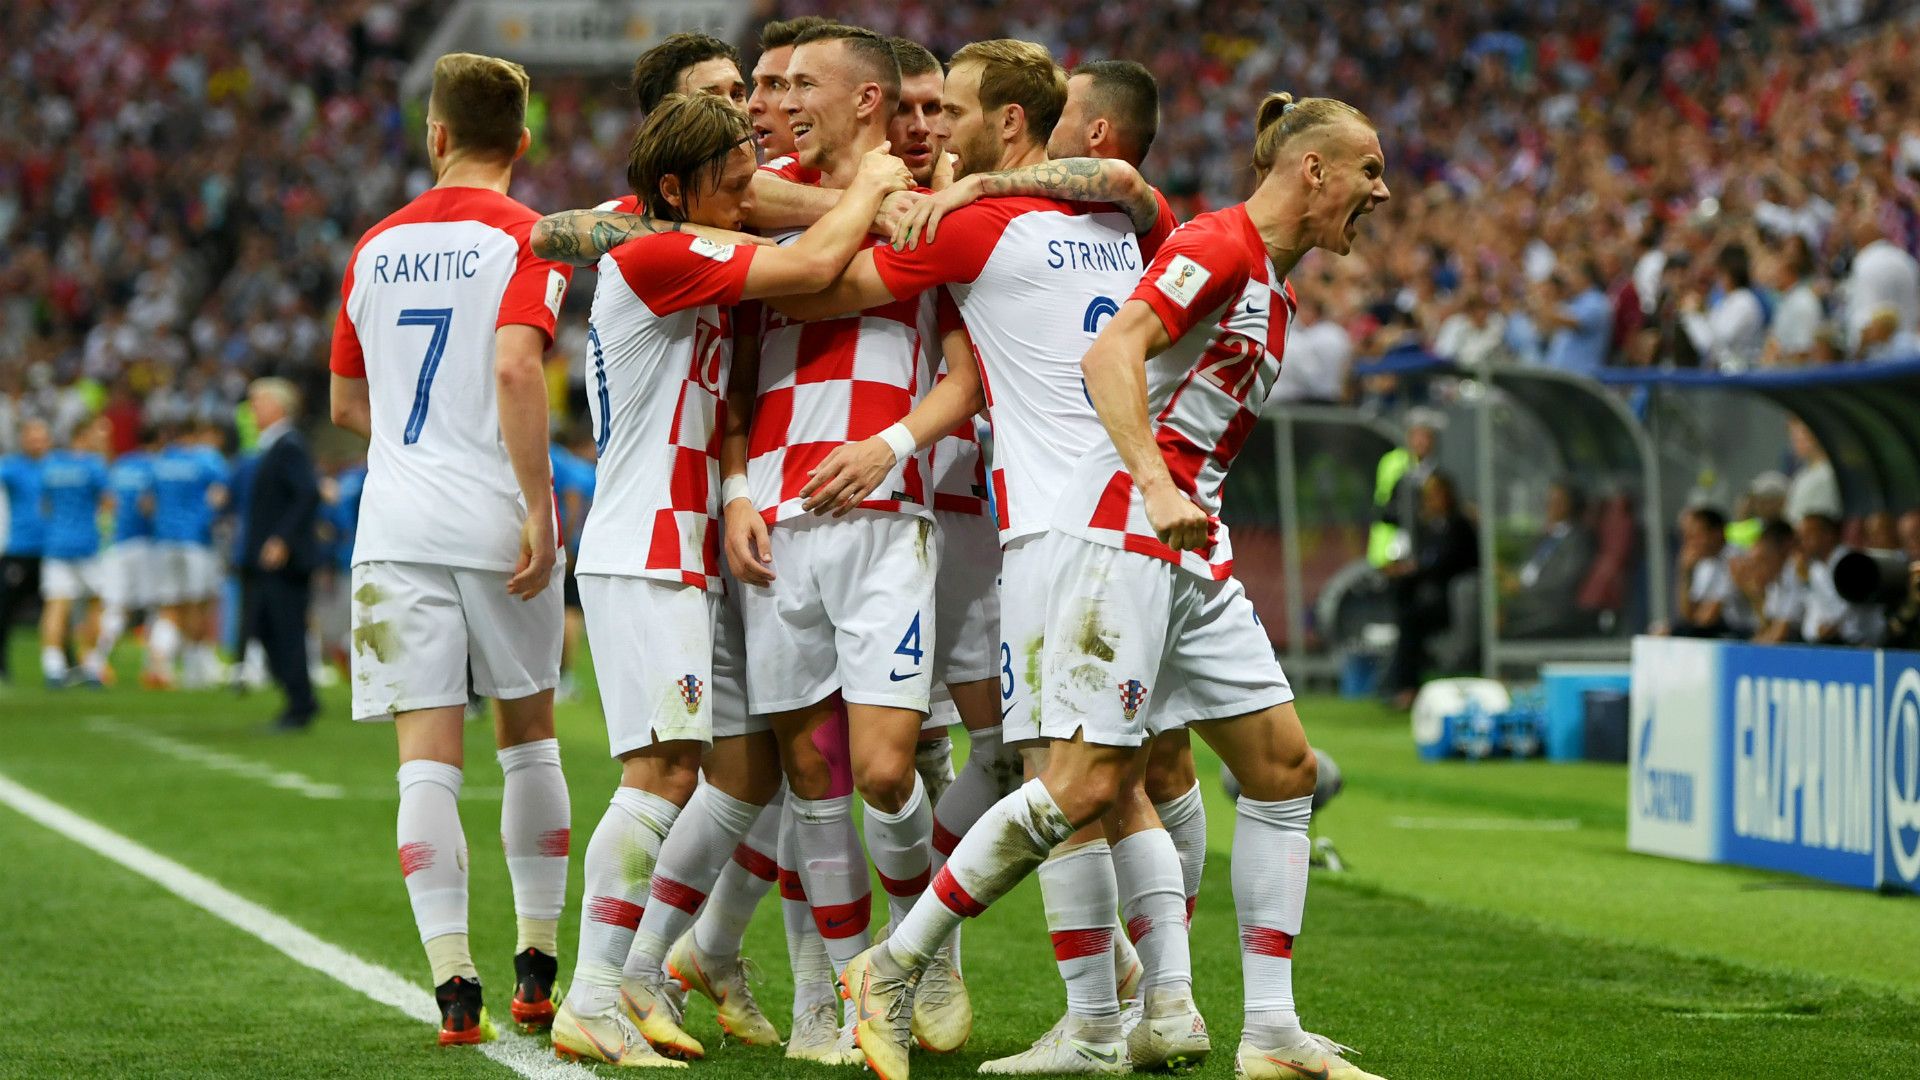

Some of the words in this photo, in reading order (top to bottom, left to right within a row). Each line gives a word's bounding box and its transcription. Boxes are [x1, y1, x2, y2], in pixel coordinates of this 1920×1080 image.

[373, 243, 480, 284] RAKITIĆ
[1047, 233, 1136, 272] STRINIĆ
[397, 307, 453, 445] 7
[1198, 334, 1264, 398] 21
[893, 608, 924, 666] 4
[1000, 641, 1015, 700] 3
[1734, 674, 1873, 855] GAZPROM
